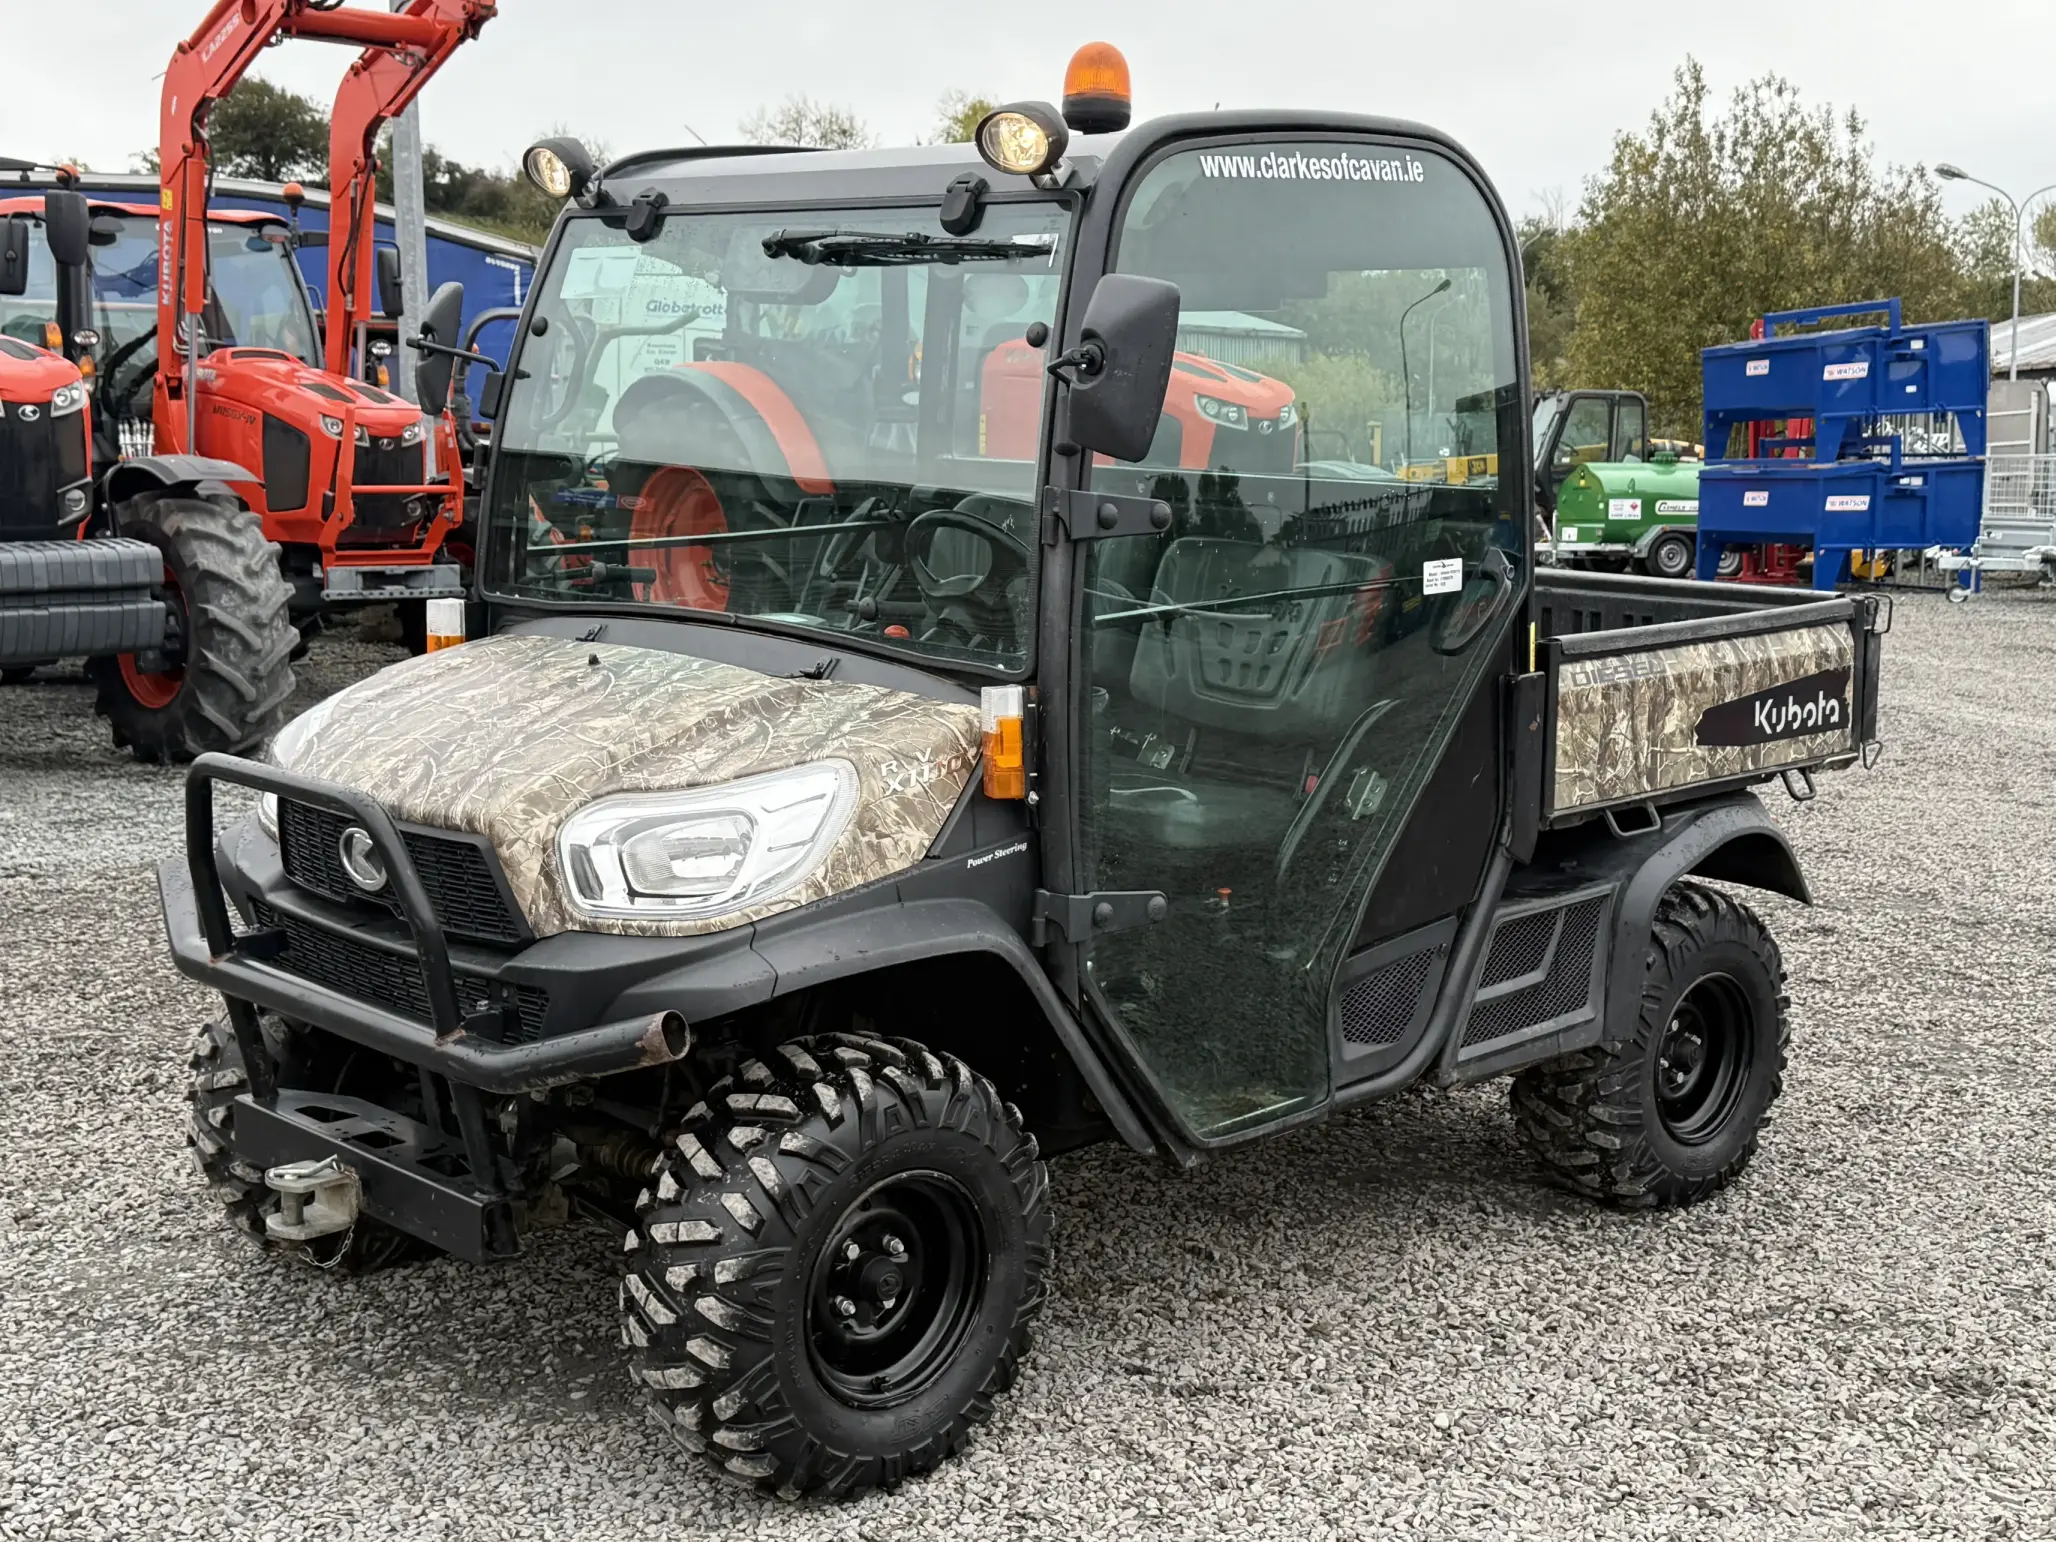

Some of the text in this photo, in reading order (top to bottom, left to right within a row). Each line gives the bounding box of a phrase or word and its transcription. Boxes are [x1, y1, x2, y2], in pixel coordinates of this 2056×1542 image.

[1200, 151, 1424, 182] www.clarkesofcavan.ie
[162, 220, 173, 305] KUBOTA
[1836, 366, 1866, 375] WATSON
[1838, 499, 1868, 507] WATSON
[1570, 659, 1667, 686] DIESEL
[1755, 691, 1840, 734] Kubota
[967, 842, 1028, 869] Power Steering
